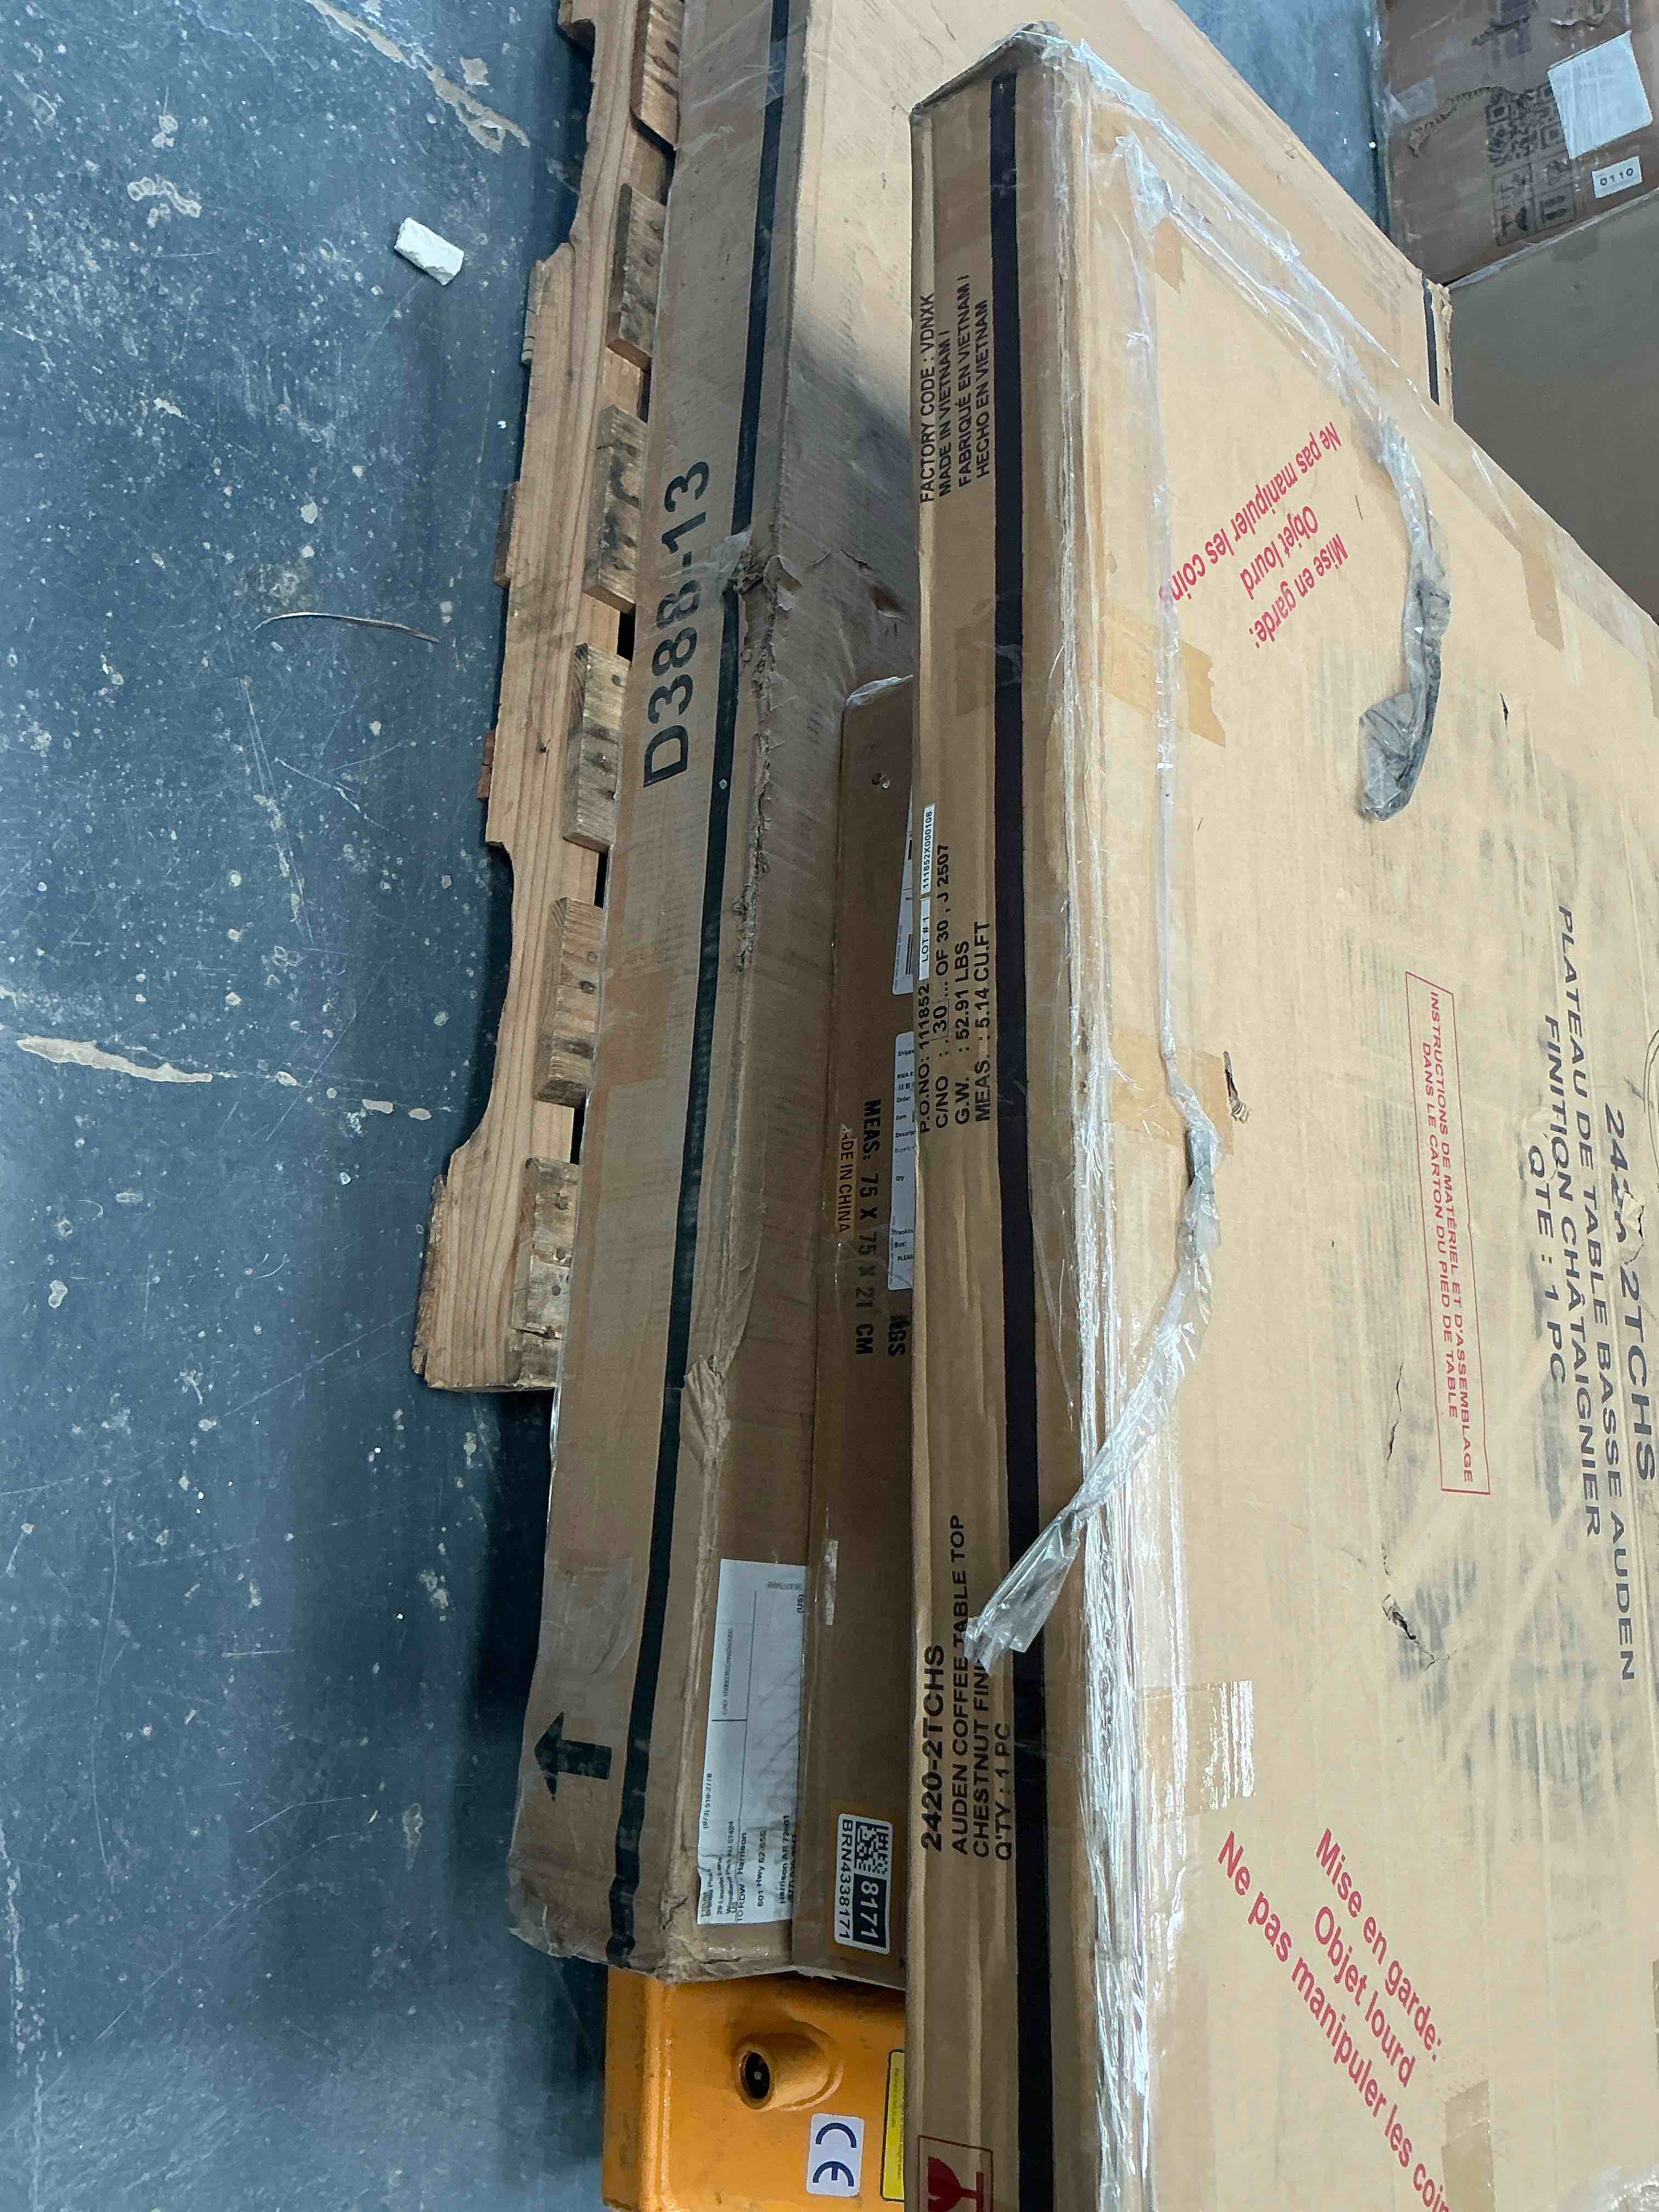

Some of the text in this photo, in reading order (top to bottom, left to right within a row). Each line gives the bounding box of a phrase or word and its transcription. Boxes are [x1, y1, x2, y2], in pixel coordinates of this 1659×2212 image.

[1600, 168, 1633, 186] 0110
[919, 292, 934, 353] VDNXK
[957, 283, 970, 363] VIETNAM
[919, 366, 935, 416] CODE
[938, 337, 951, 417] VIETNAM
[957, 366, 970, 391] EN
[974, 300, 990, 478] HECHO EN VIETNAM
[939, 422, 951, 440] IN
[955, 393, 972, 487] FABRIQUÉ
[1296, 432, 1322, 473] pas
[1319, 421, 1342, 451] Ne
[919, 422, 935, 503] FACTORY
[939, 445, 951, 496] MADE
[1230, 462, 1298, 541] manipuler
[1205, 528, 1234, 564] les
[1240, 506, 1318, 600] Objet lourd
[1249, 533, 1348, 649] Mise en garde:
[643, 461, 709, 788] D388-13
[936, 844, 949, 885] 2507
[936, 893, 949, 902] J
[921, 938, 929, 962] LOT
[922, 926, 929, 934] #
[936, 921, 949, 943] 30
[974, 921, 989, 981] CU.FT
[936, 947, 949, 975] OF
[955, 941, 969, 981] LBS
[918, 983, 931, 1049] 111852
[933, 1006, 947, 1033] 30
[955, 989, 969, 1040] 52.91
[974, 988, 989, 1028] 5.14
[935, 1076, 949, 1128] C/NO
[955, 1077, 969, 1124] G.W.
[974, 1054, 990, 1122] MEAS.
[840, 1164, 854, 1180] IN
[860, 1173, 878, 1198] 75
[1528, 1145, 1553, 1238] QTE
[838, 1184, 853, 1233] CHINA
[860, 1206, 878, 1220] X
[1423, 1042, 1459, 1419] DANS LE CARTON DU PIED DE TABLE
[859, 1232, 877, 1256] 75
[1430, 991, 1474, 1483] INSTRUCTIONS DE MATÉRIEL ET D'ASSEMBLAGE
[855, 1286, 874, 1308] 21
[1544, 1015, 1601, 1537] FINITION CHÂTAIGNIER
[1544, 1285, 1559, 1301] 1
[1559, 906, 1635, 1680] PLATEAU DE TABLE BASSE AUDEN
[856, 1323, 873, 1355] CM
[1547, 1321, 1566, 1384] PC
[950, 1515, 968, 1854] AUDEN COFFEE TABLE TOP
[921, 1645, 944, 1853] 2420-2TCHS
[995, 1723, 1010, 1757] PC
[973, 1719, 989, 1858] CHESTNUT
[995, 1769, 1011, 1778] 1
[995, 1800, 1012, 1860] Q'TY
[756, 1866, 765, 1887] Hwy
[839, 1819, 853, 1939] BRN4338171
[861, 1881, 879, 1938] 8171
[1316, 1828, 1442, 2063] Mise en garde:
[1218, 1831, 1252, 1896] Ne
[1247, 1891, 1292, 1962] pas
[1291, 1957, 1387, 2118] manipuler
[1384, 2104, 1413, 2168] les
[1315, 1906, 1416, 2088] Objet lourd
[812, 2122, 857, 2187] CE
